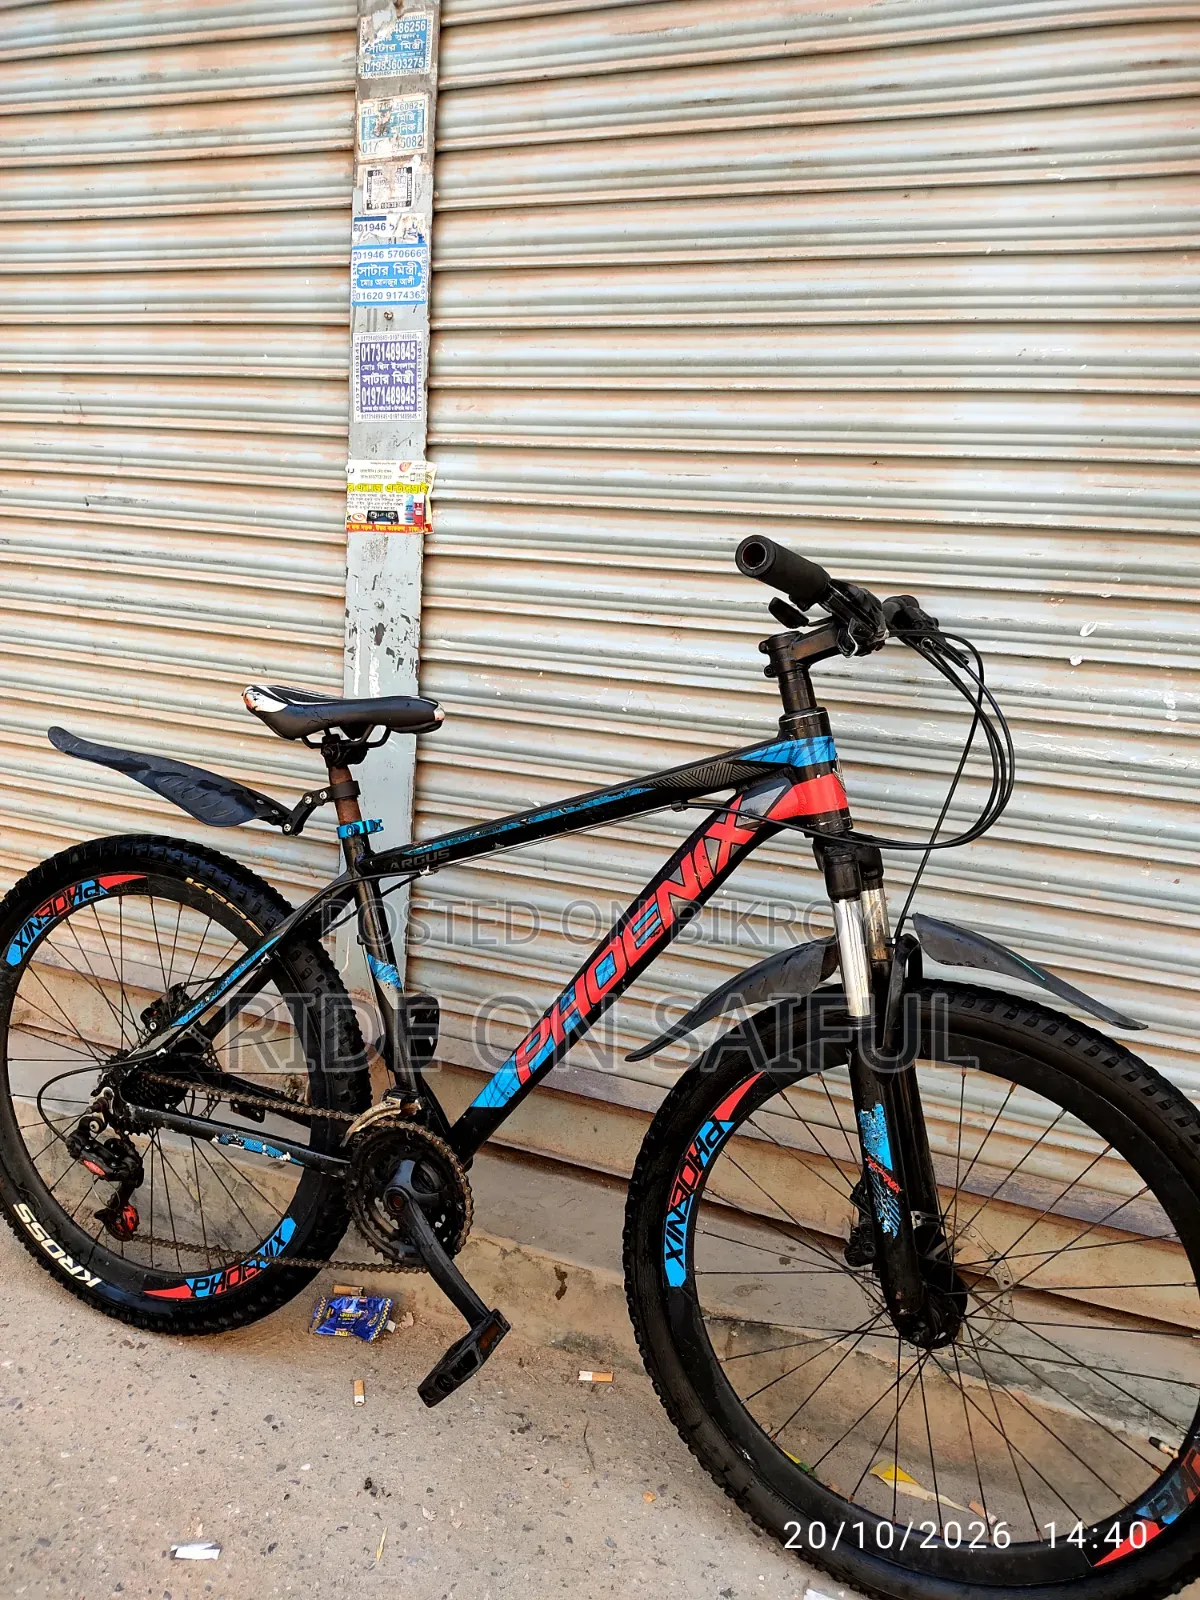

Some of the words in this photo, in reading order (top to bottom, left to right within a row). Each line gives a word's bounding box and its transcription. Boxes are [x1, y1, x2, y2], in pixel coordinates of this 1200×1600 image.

[387, 249, 421, 259] 570666
[361, 341, 416, 362] 01731489845
[361, 386, 416, 406] 01971489845
[390, 848, 450, 871] ARGUS
[13, 880, 101, 957] PHOENIX
[514, 795, 758, 1084] PHOENIX
[664, 1116, 730, 1269] PHOENIX
[13, 1203, 103, 1288] KROSS
